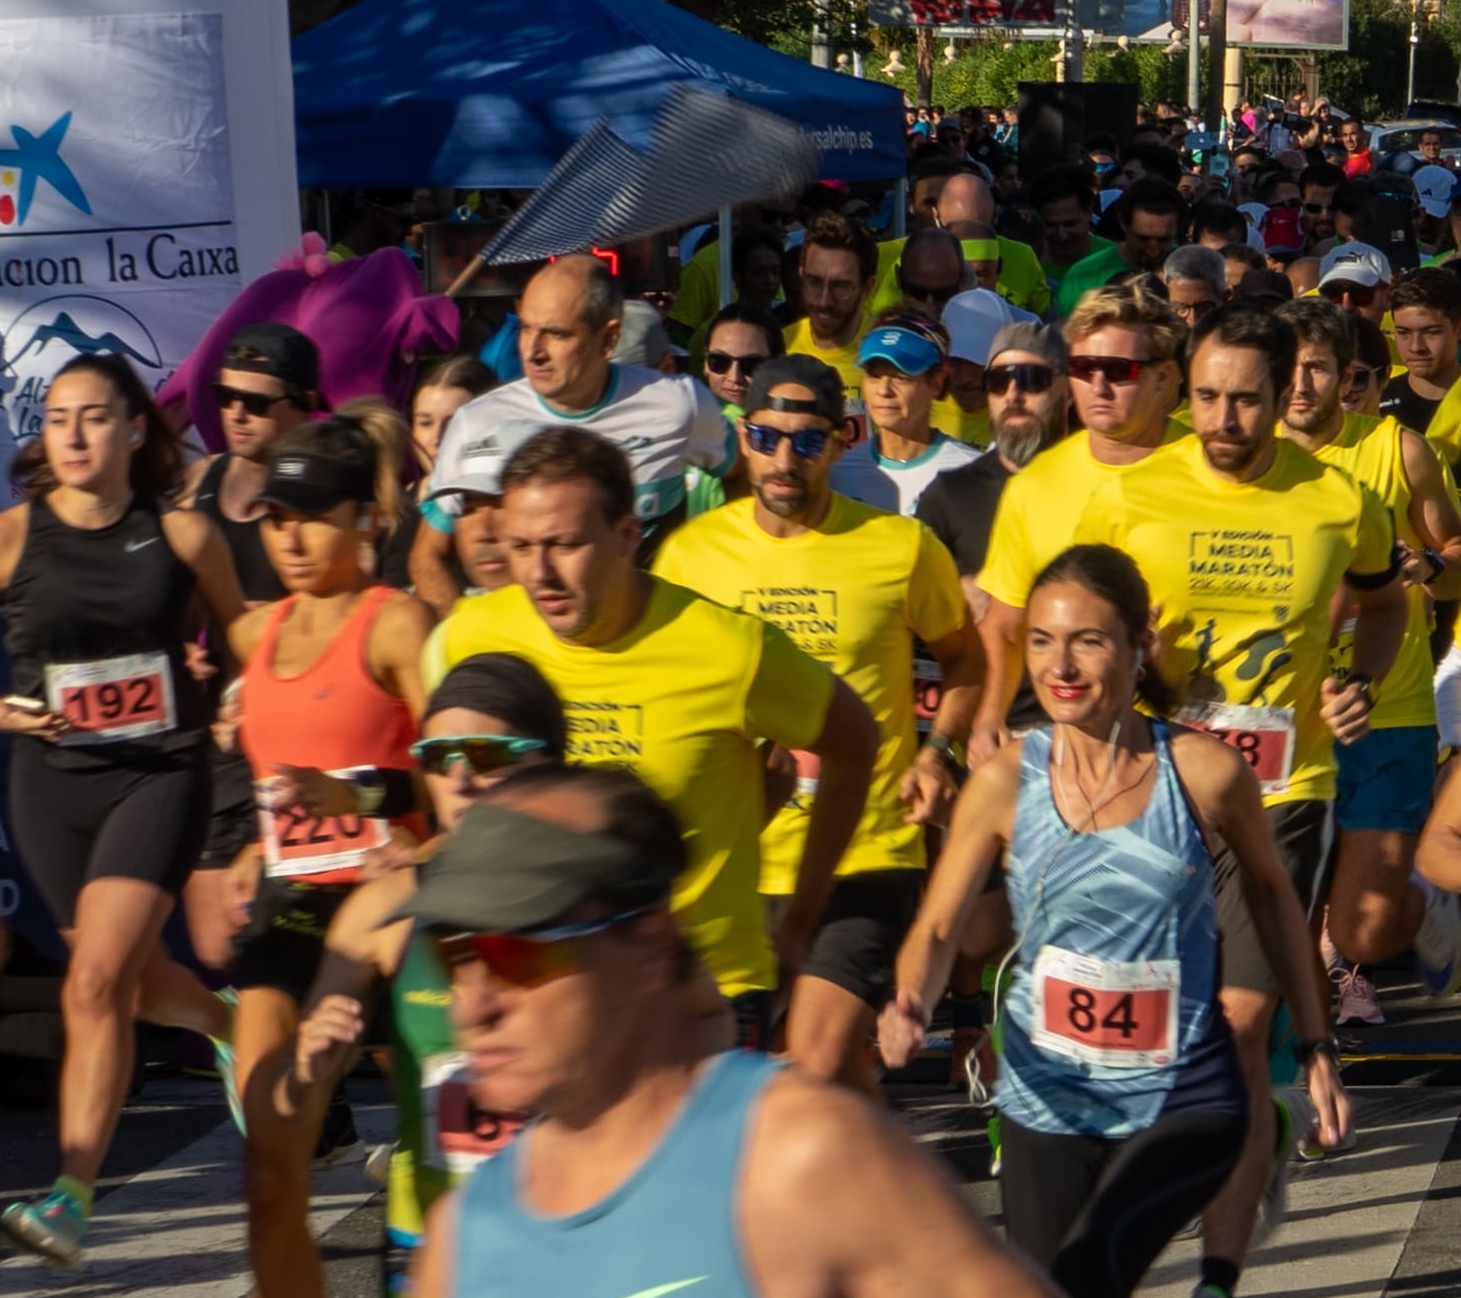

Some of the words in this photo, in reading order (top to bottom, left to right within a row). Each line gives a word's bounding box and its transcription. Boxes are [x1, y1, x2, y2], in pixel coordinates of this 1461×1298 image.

[104, 237, 138, 283] la
[146, 233, 240, 282] Caixa
[1208, 544, 1273, 559] MEDIA
[1189, 560, 1294, 578] MARATÓN
[758, 600, 820, 615] MEDIA
[65, 678, 158, 731] 192
[565, 716, 620, 734] EDIA
[1067, 987, 1138, 1039] 84
